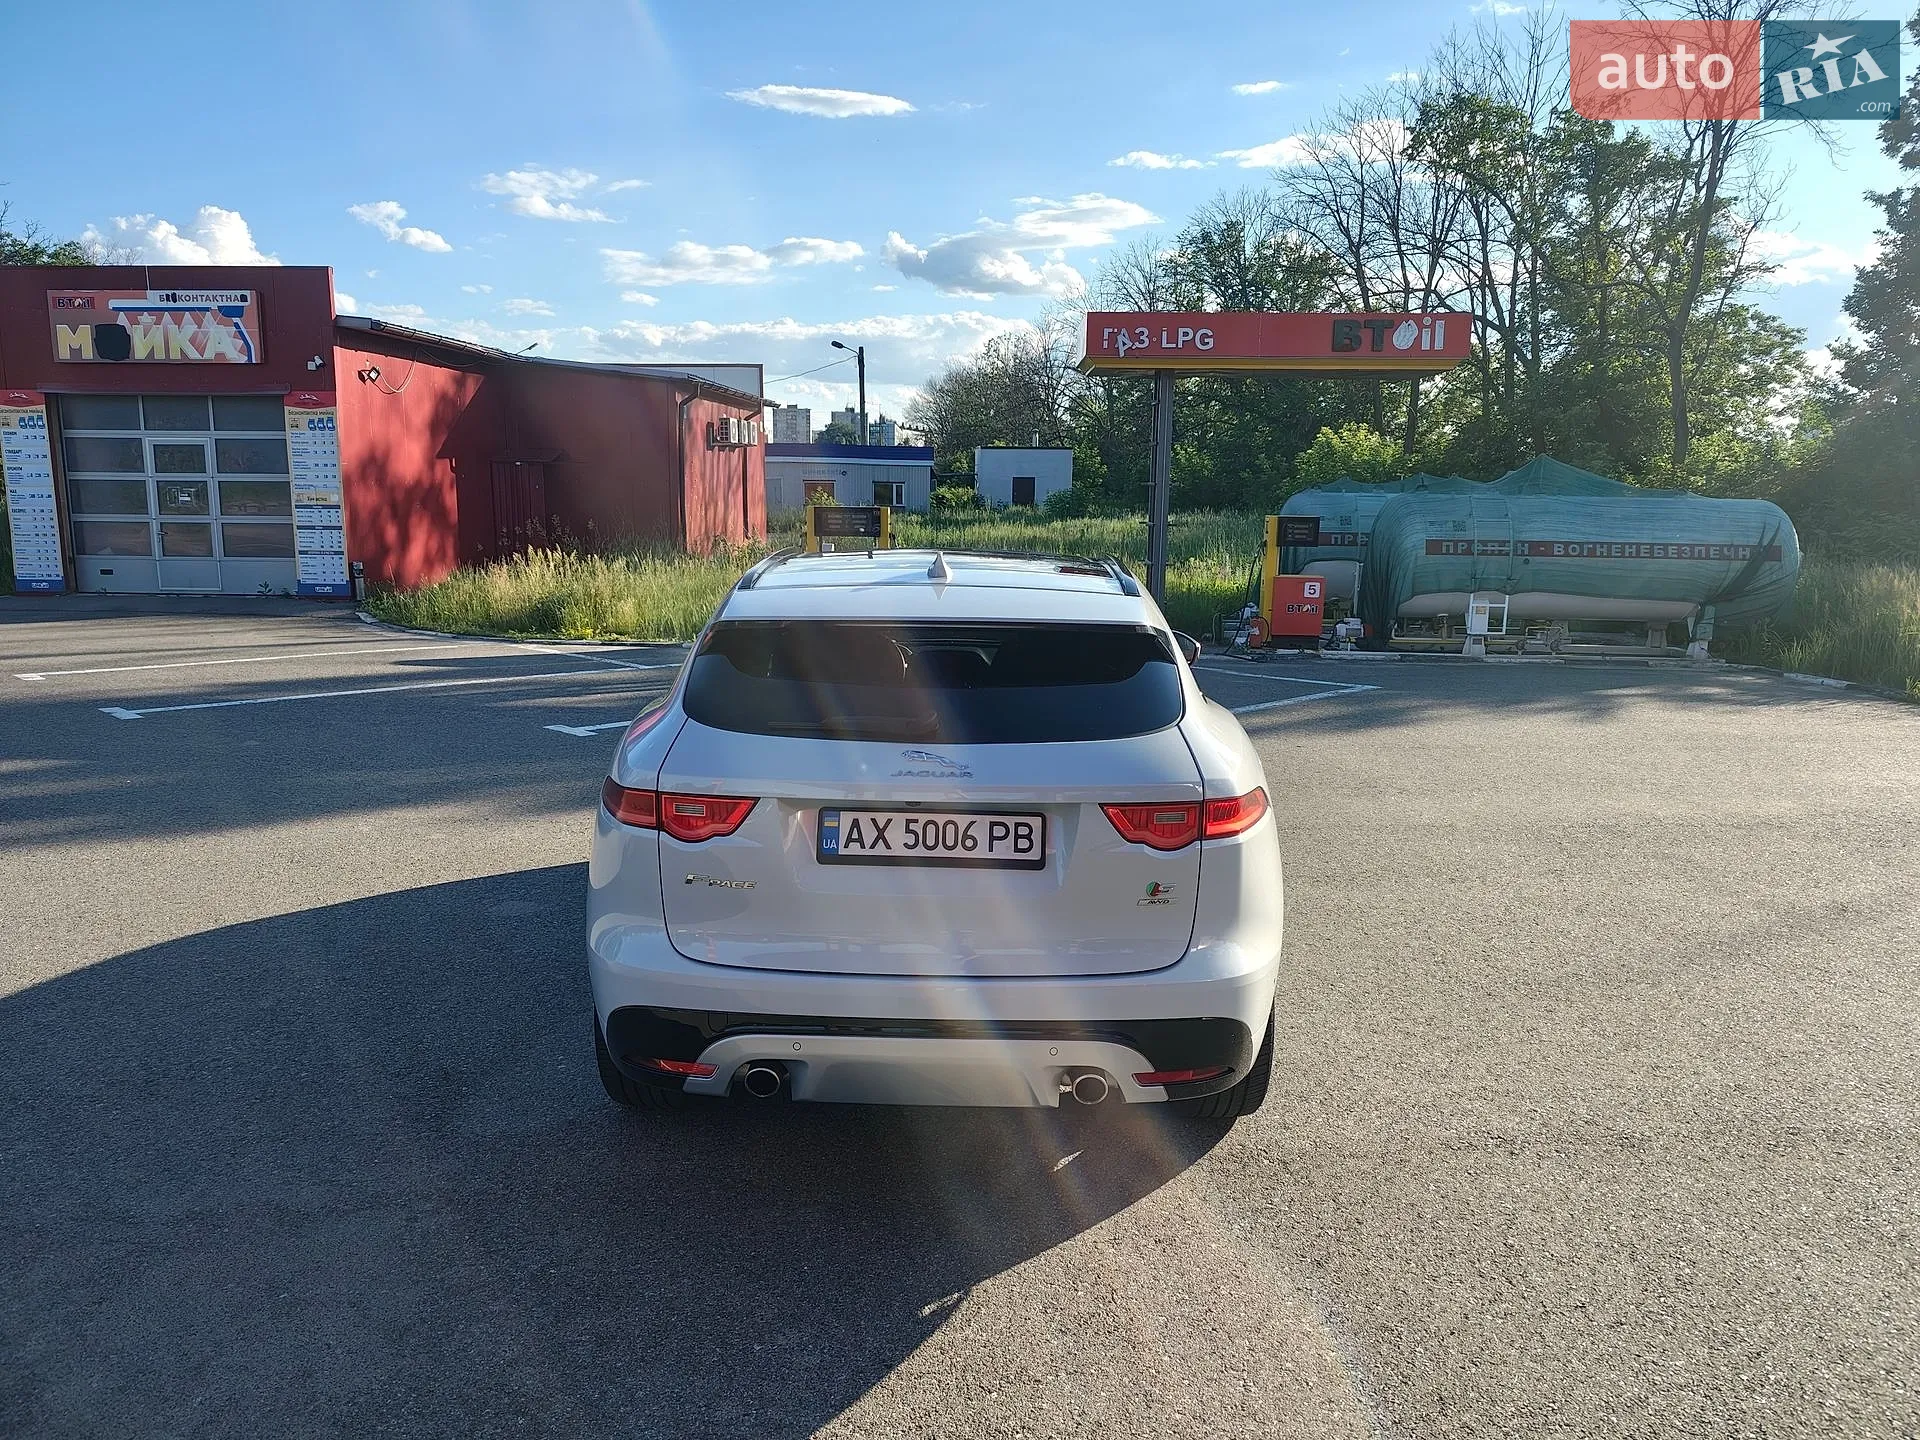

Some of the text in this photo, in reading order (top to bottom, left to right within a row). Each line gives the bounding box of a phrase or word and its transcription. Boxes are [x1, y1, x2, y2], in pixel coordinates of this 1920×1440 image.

[159, 293, 248, 304] БКОНТАКТНА
[56, 316, 240, 360] МЙКА
[1161, 327, 1214, 350] LPG
[1308, 584, 1317, 595] 5
[890, 770, 974, 778] JAGUAR
[843, 818, 1034, 854] AX 5006 PB
[823, 839, 838, 849] UA
